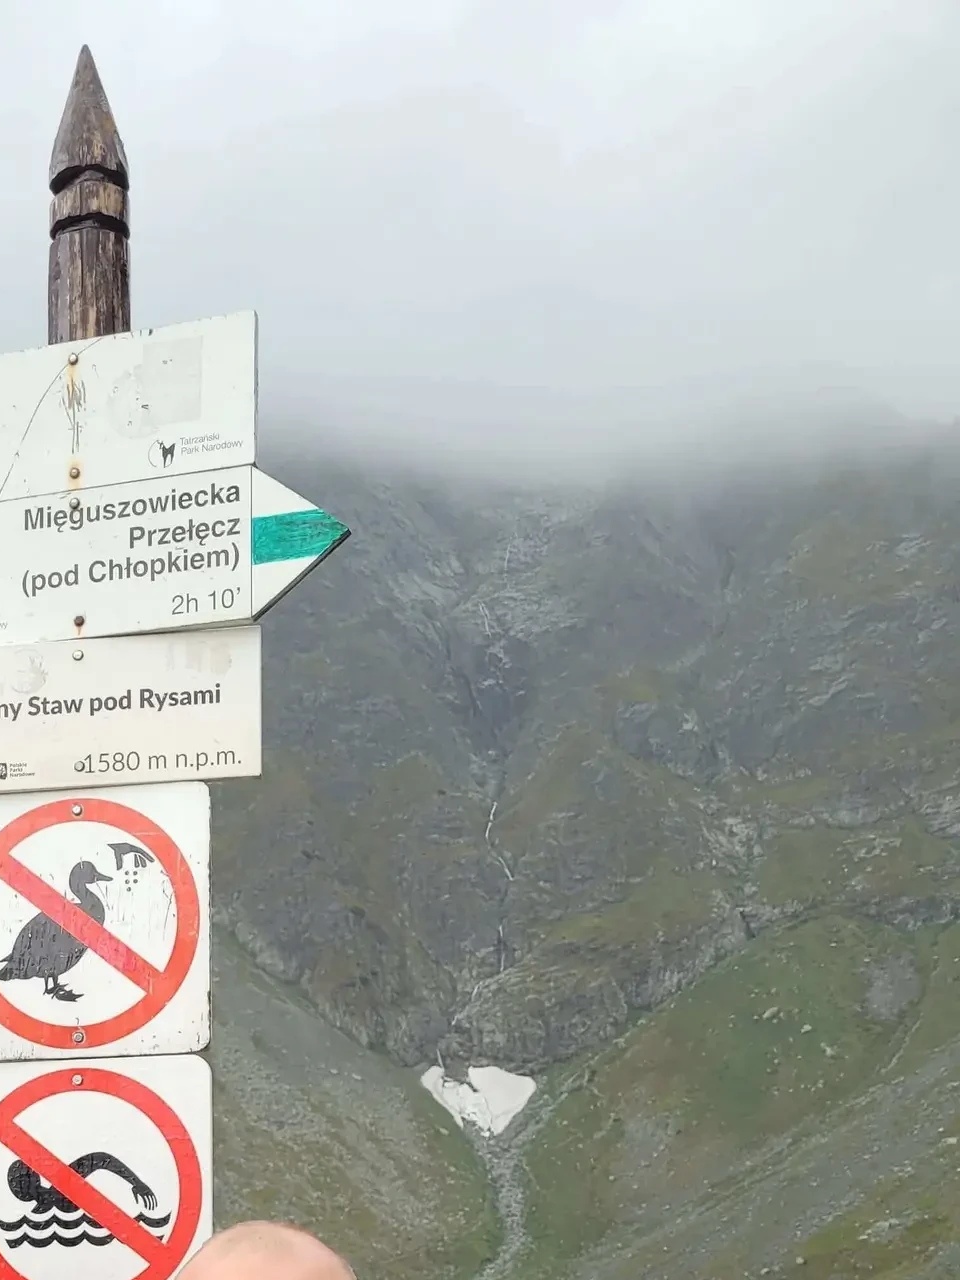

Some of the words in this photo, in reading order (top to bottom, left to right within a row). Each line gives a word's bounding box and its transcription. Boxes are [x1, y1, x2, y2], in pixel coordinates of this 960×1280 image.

[181, 446, 200, 456] Park
[201, 440, 244, 453] Narodowy
[23, 483, 242, 532] Mięguszowiecka
[128, 517, 242, 550] Przełęcz
[21, 564, 80, 598] (pod
[88, 542, 241, 582] Chłopkiem)
[171, 594, 199, 616] 2h
[27, 695, 83, 716] Staw
[89, 689, 133, 717] pod
[139, 682, 222, 711] Rysami
[83, 750, 141, 774] 1580
[148, 754, 168, 771] m
[175, 747, 243, 771] n.p.m.
